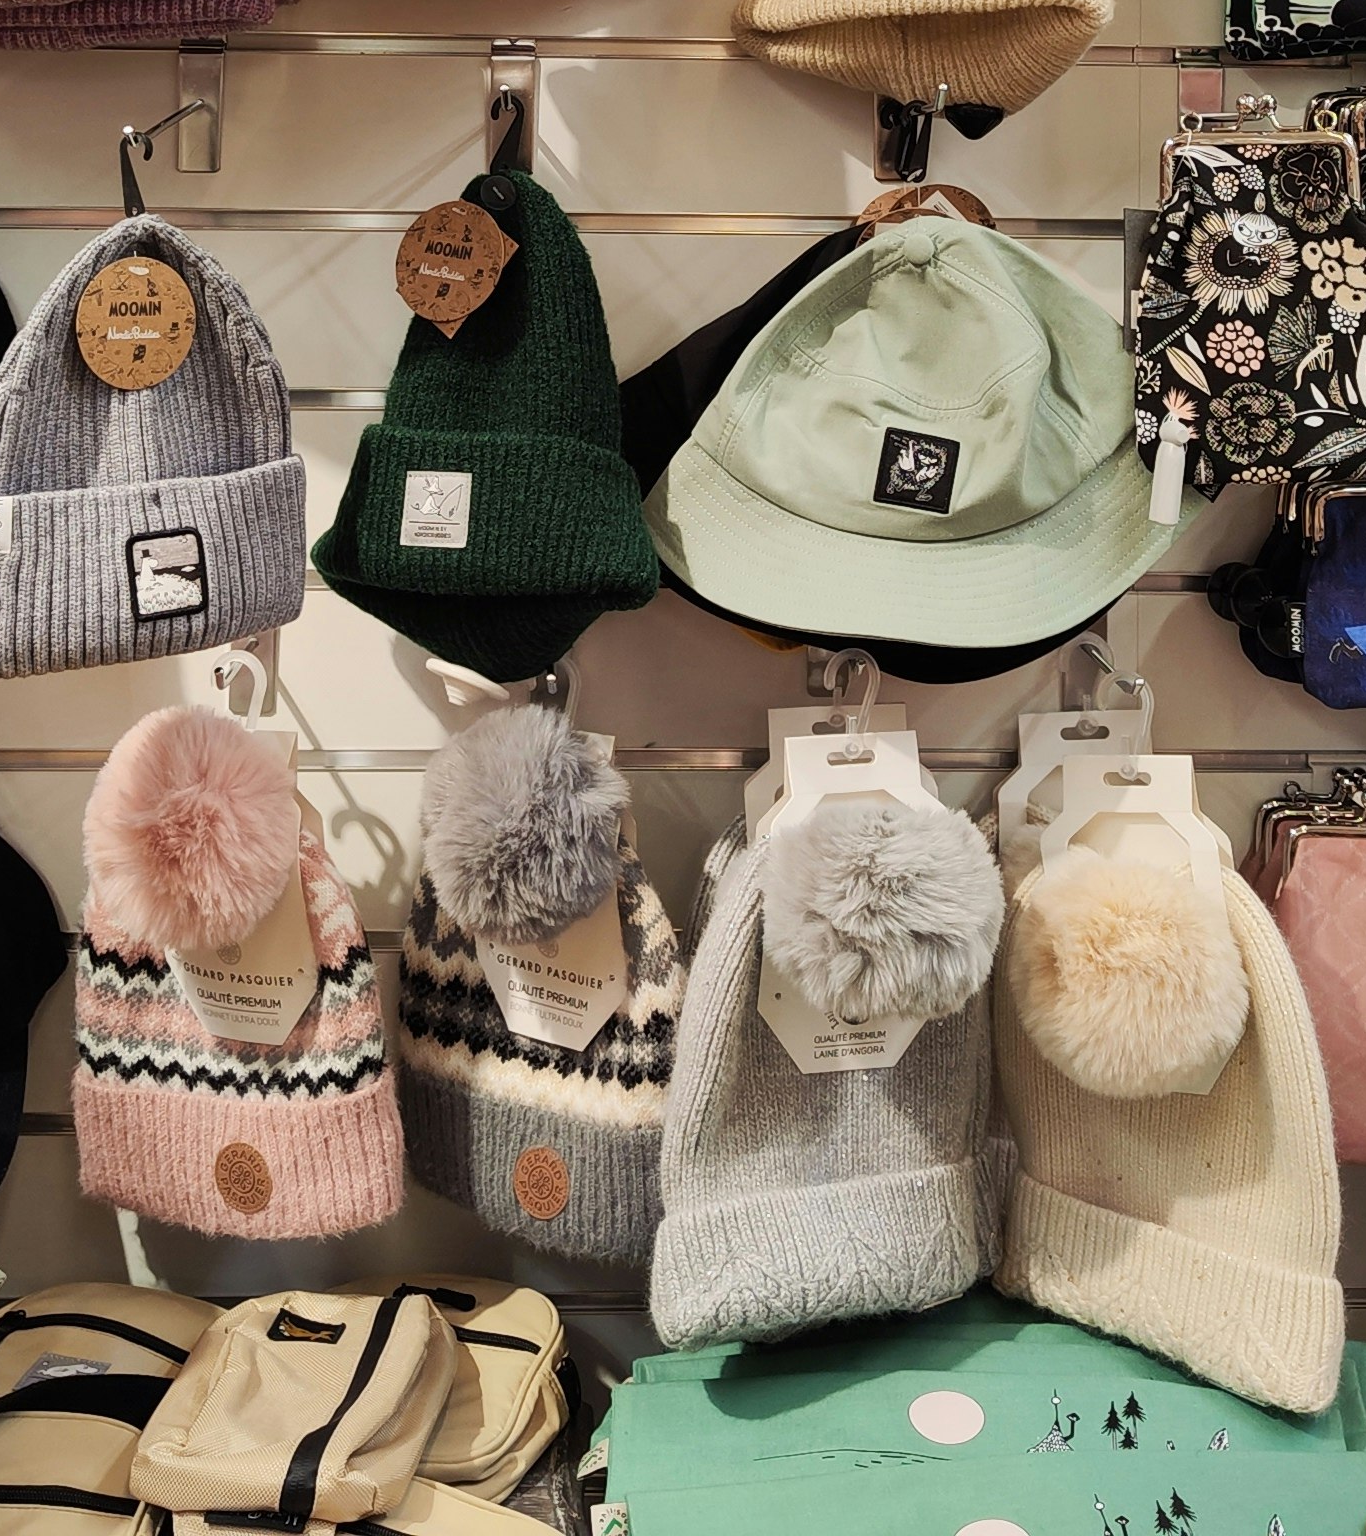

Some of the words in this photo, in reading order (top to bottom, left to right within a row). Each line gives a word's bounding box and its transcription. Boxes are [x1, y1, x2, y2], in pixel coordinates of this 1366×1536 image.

[424, 239, 473, 261] MOOMIN
[108, 300, 162, 317] MOOMIN
[1290, 607, 1302, 653] MOOMIN
[182, 961, 225, 982] GERARD
[229, 973, 294, 987] PASQUIER
[496, 952, 542, 974] GERARD
[546, 964, 604, 991] PASQUIER
[196, 987, 234, 1006] QUALITÉ
[234, 995, 282, 1009] PREMIUM
[507, 979, 544, 1001] QUALITÉ
[544, 990, 588, 1011] PREMIUM
[813, 1032, 848, 1044] QUALITÉ
[848, 1030, 886, 1041] PREMIUM
[813, 1048, 839, 1060] LAINE
[841, 1045, 885, 1058] D'ANGORA
[219, 1149, 263, 1174] GERARD
[520, 1153, 563, 1181] GERARD
[219, 1176, 266, 1206] PASQUIER
[518, 1179, 565, 1213] PASQUIER
